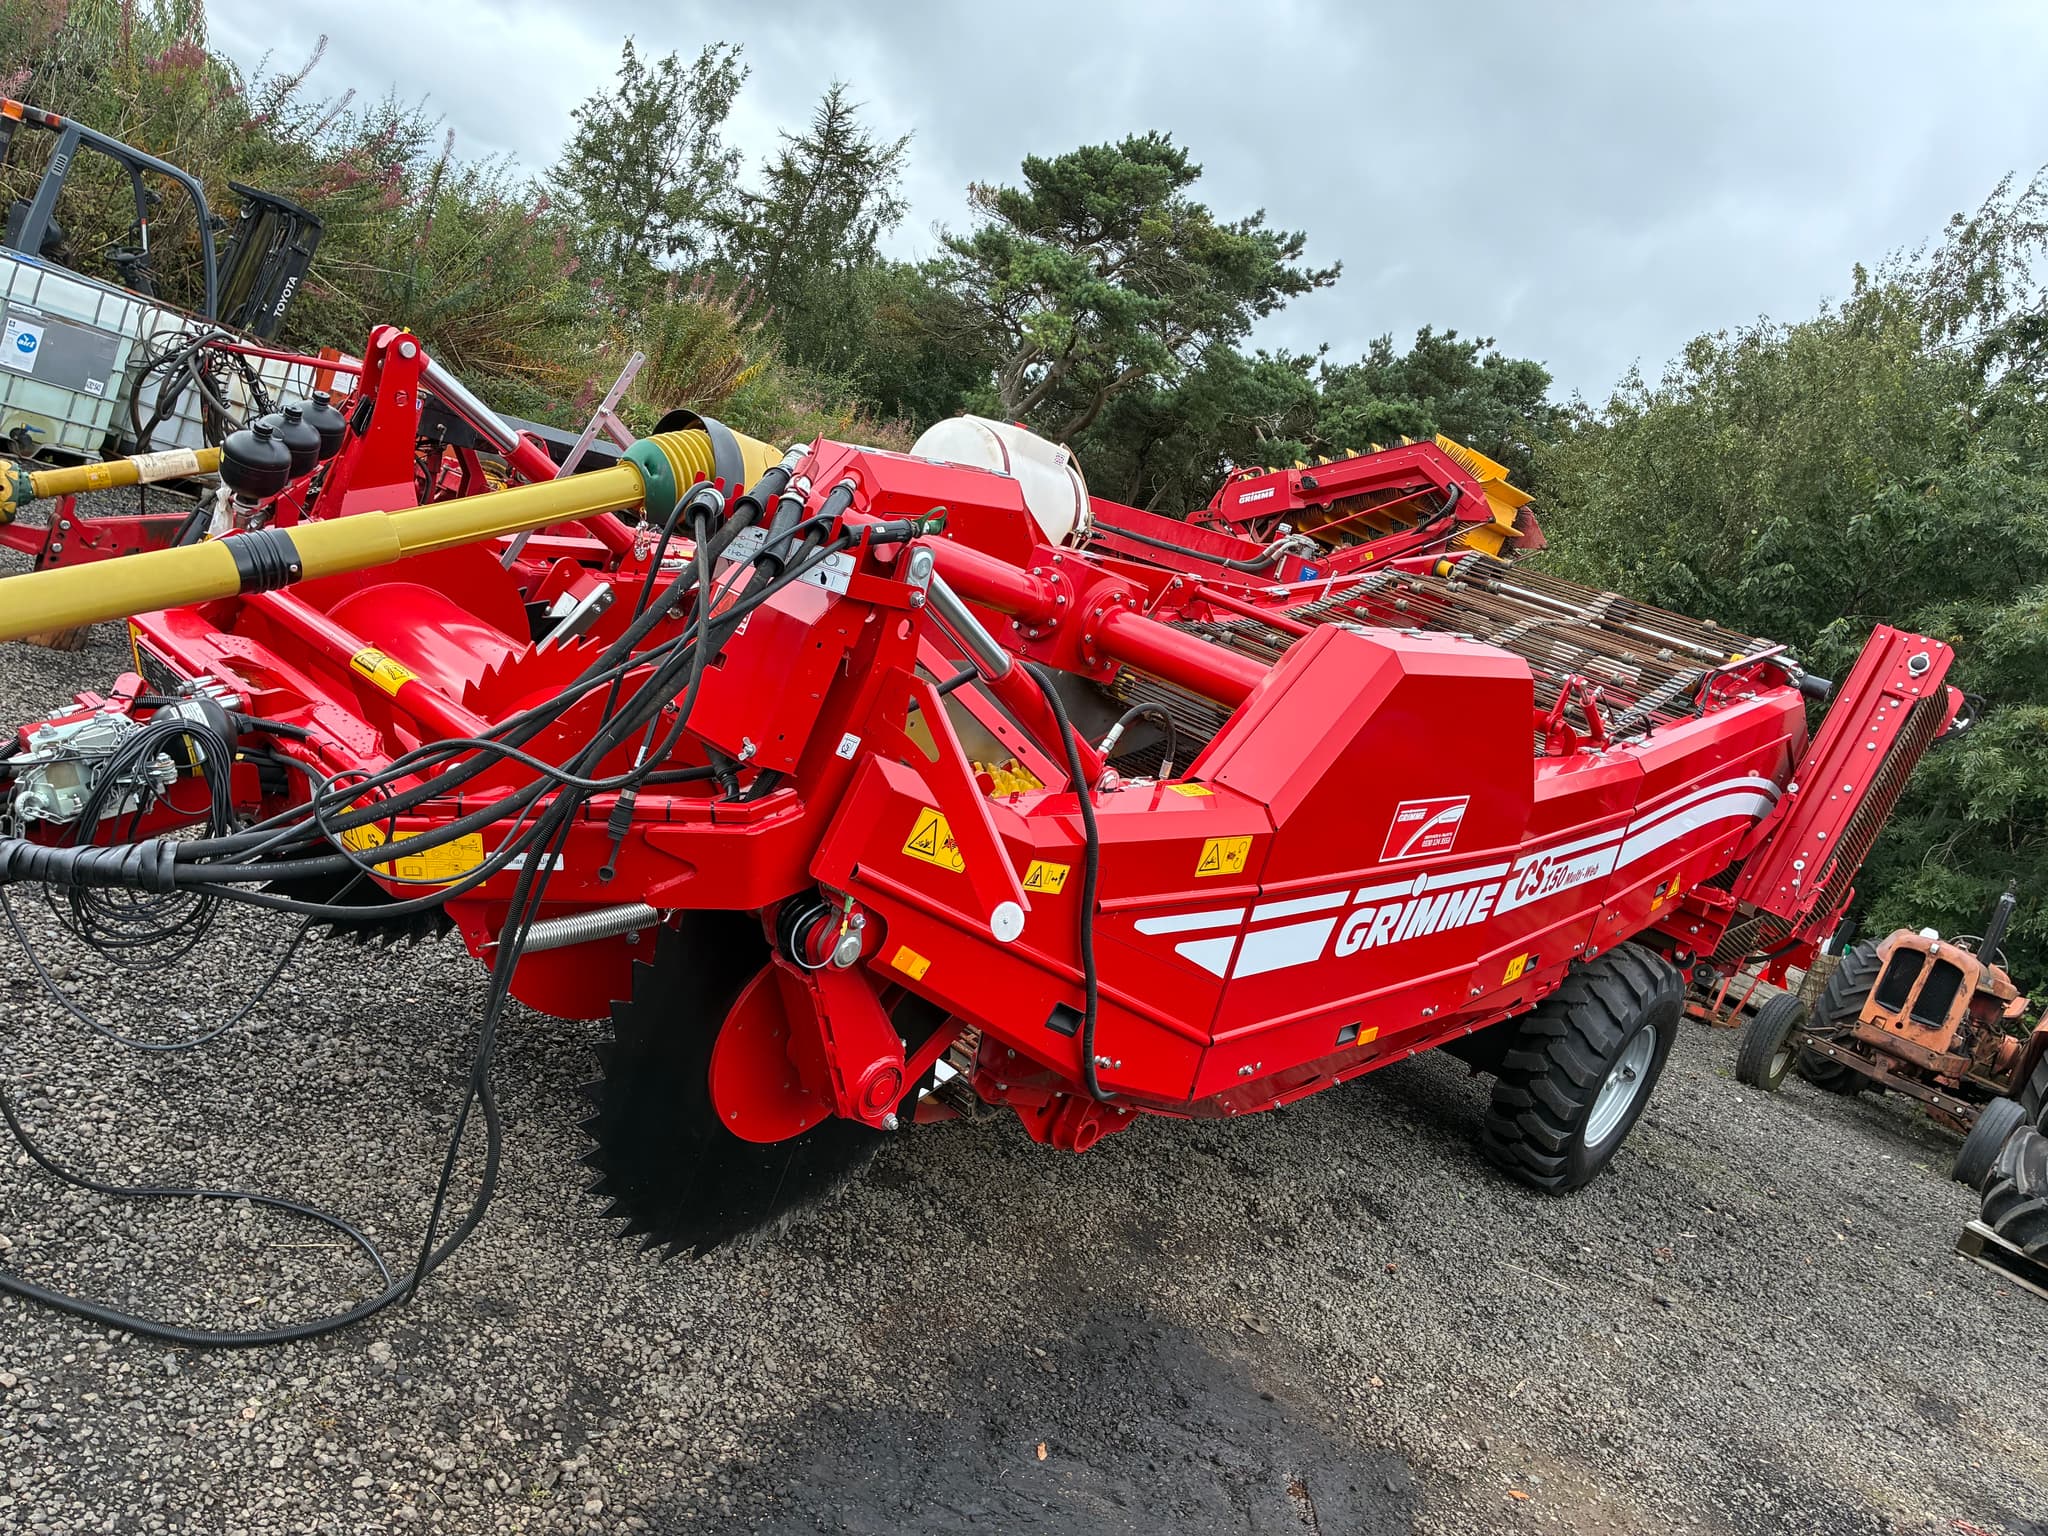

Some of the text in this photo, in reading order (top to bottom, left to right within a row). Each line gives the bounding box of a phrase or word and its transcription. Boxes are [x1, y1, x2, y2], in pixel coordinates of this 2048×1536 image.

[273, 276, 298, 317] TOYOTA
[1239, 488, 1275, 504] GRIMME
[1335, 873, 1501, 958] GRIMME
